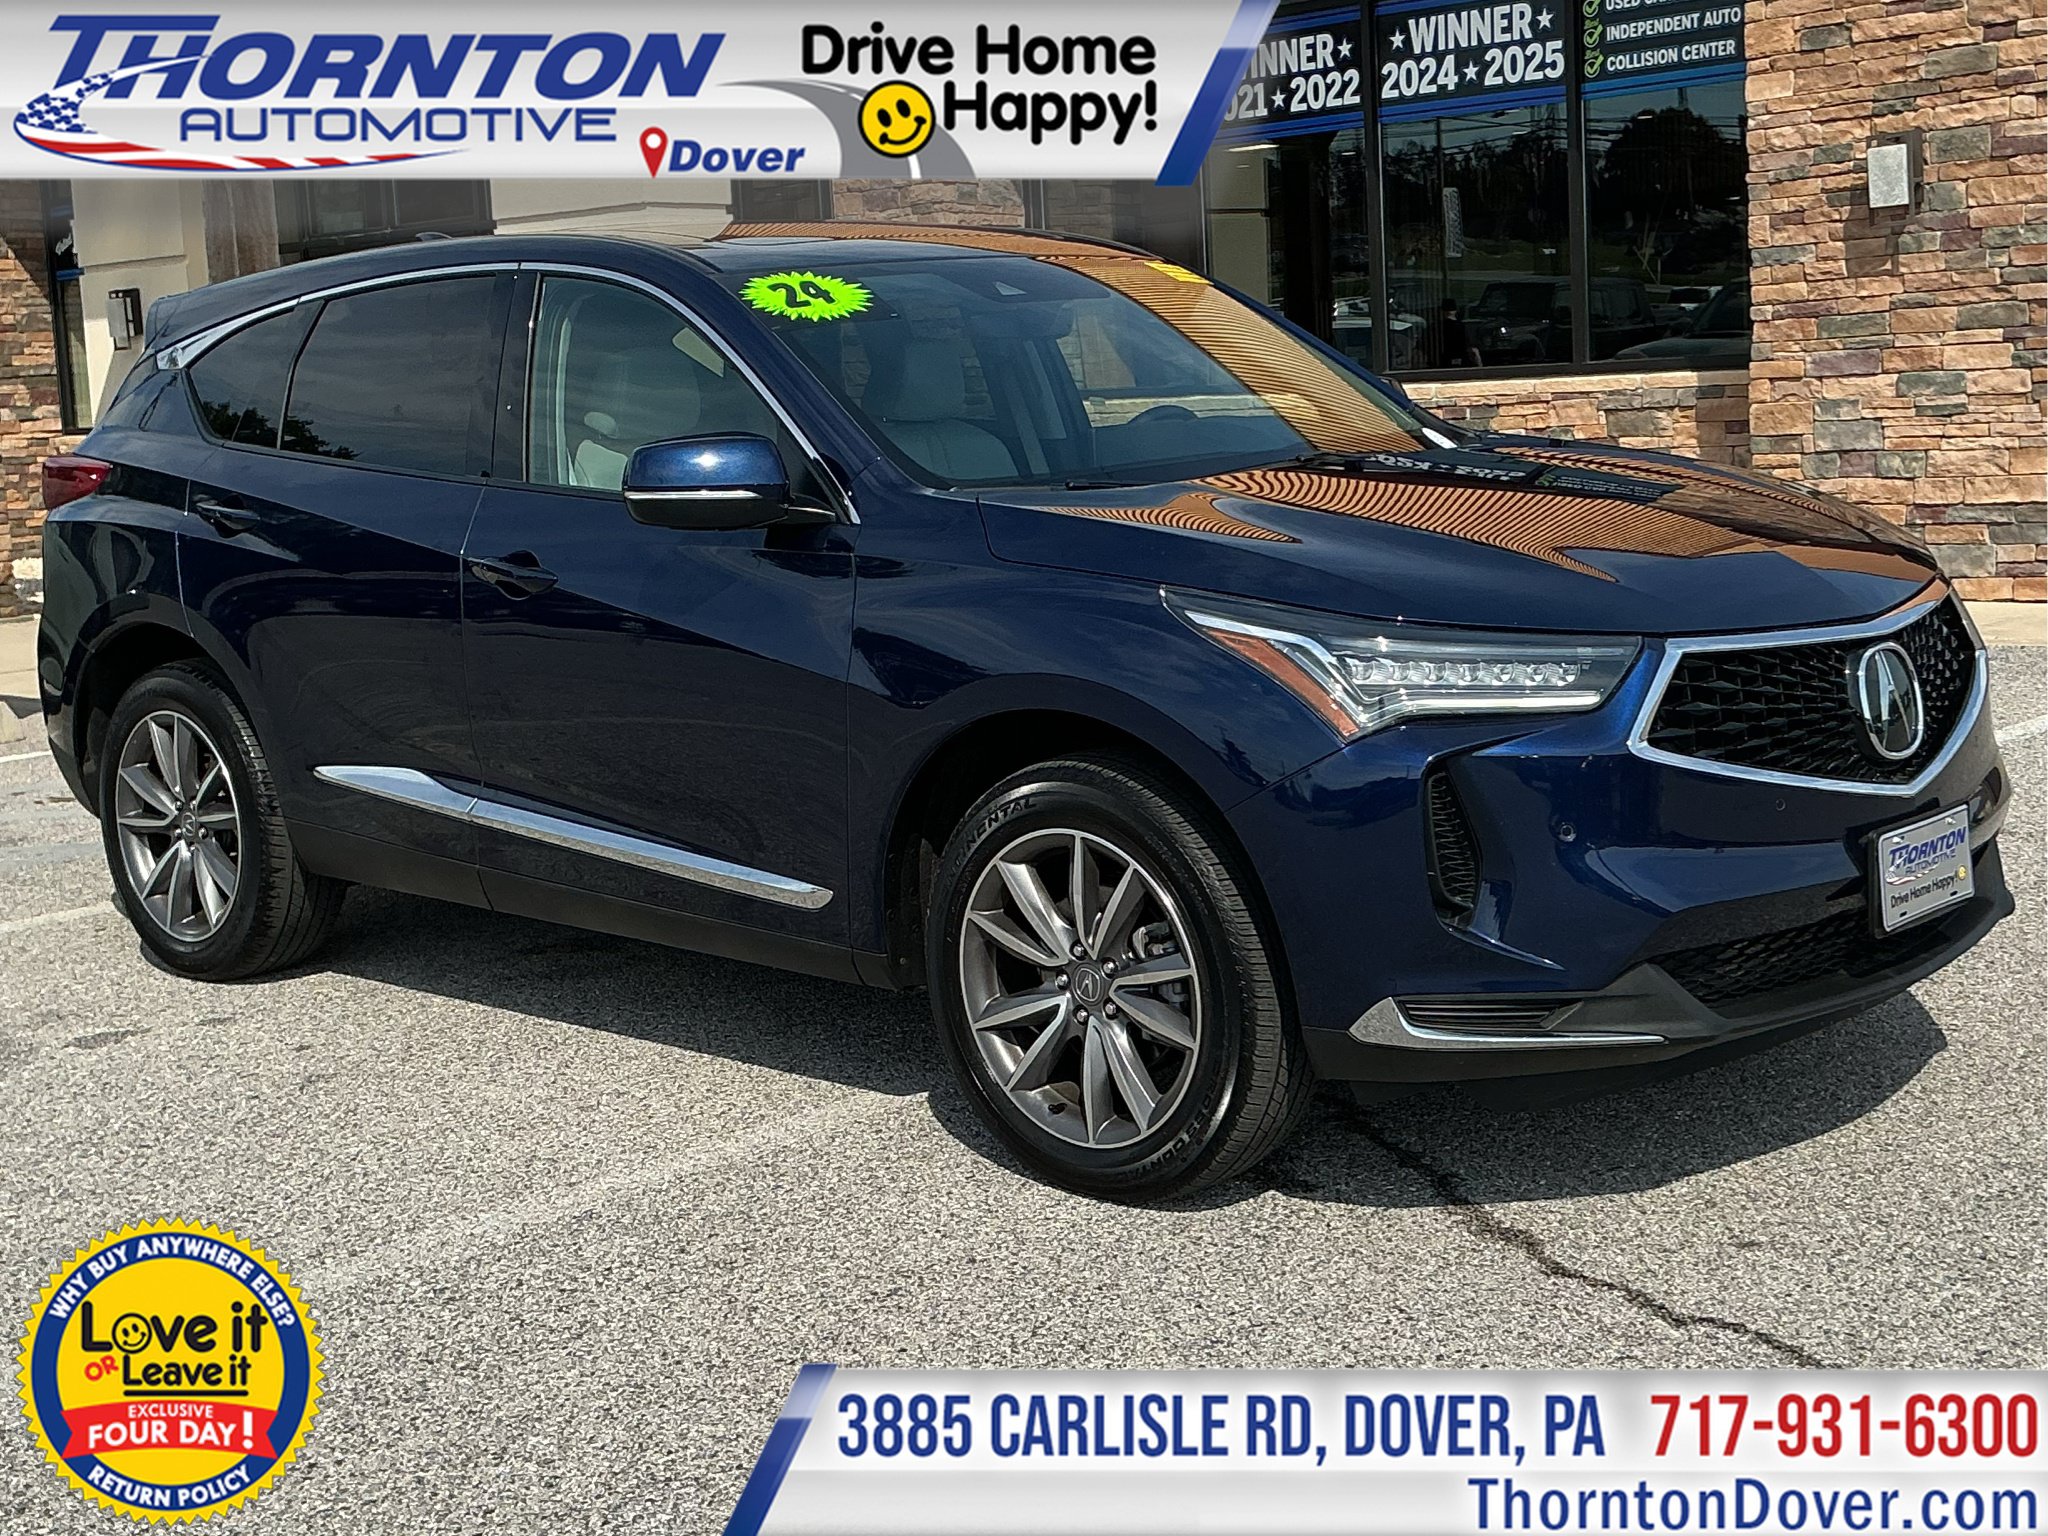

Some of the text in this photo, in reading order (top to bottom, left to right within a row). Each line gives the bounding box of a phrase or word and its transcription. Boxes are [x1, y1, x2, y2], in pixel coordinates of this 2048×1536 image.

[1408, 3, 1533, 54] WINNER
[1606, 13, 1700, 41] INDEPENDENT
[1703, 7, 1741, 27] AUTO
[1243, 33, 1335, 80] INNER
[1381, 40, 1565, 99] 2024 2025
[1607, 47, 1678, 71] COLLISION
[1681, 40, 1736, 61] CENTER
[1290, 69, 1361, 112] 2022
[767, 280, 836, 309] 24
[1889, 826, 1967, 868] THORNTON
[1890, 870, 1958, 908] Drive Home Happy!
